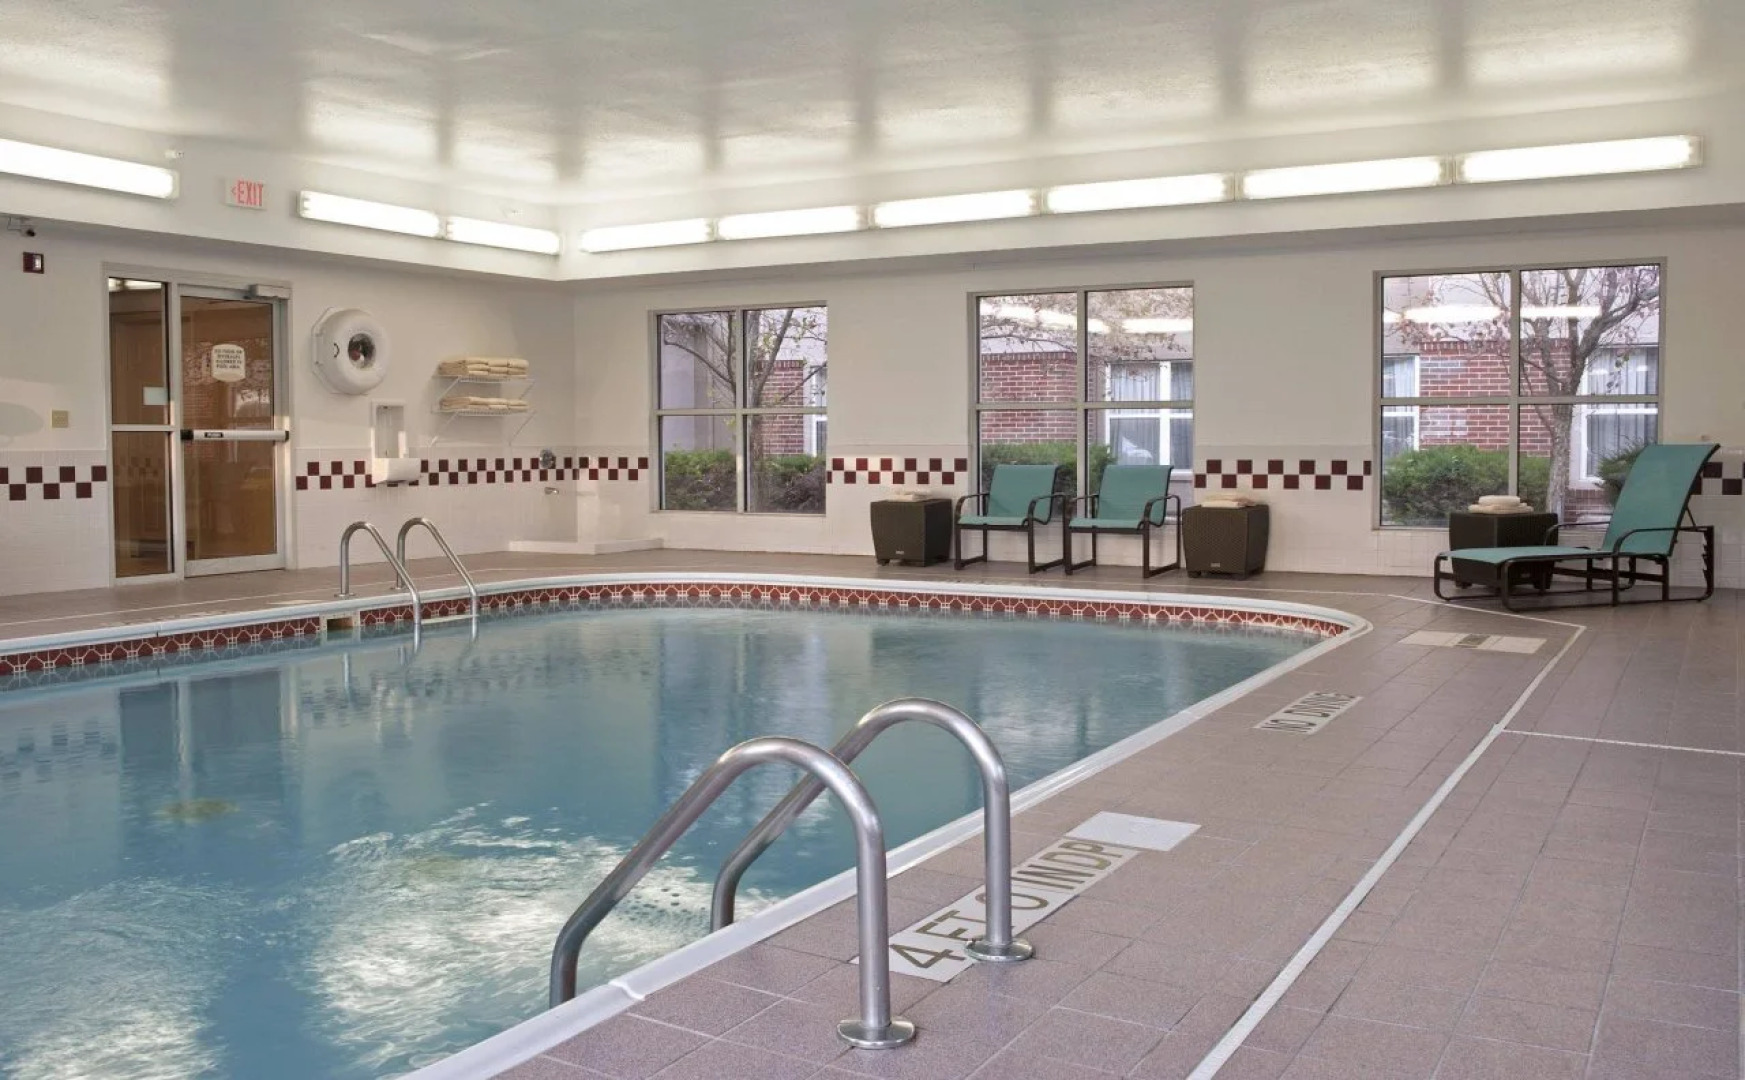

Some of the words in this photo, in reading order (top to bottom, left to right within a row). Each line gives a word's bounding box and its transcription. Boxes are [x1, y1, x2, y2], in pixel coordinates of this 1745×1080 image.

[237, 179, 263, 207] EXIT
[1261, 717, 1317, 733] NO
[889, 943, 967, 969] 4
